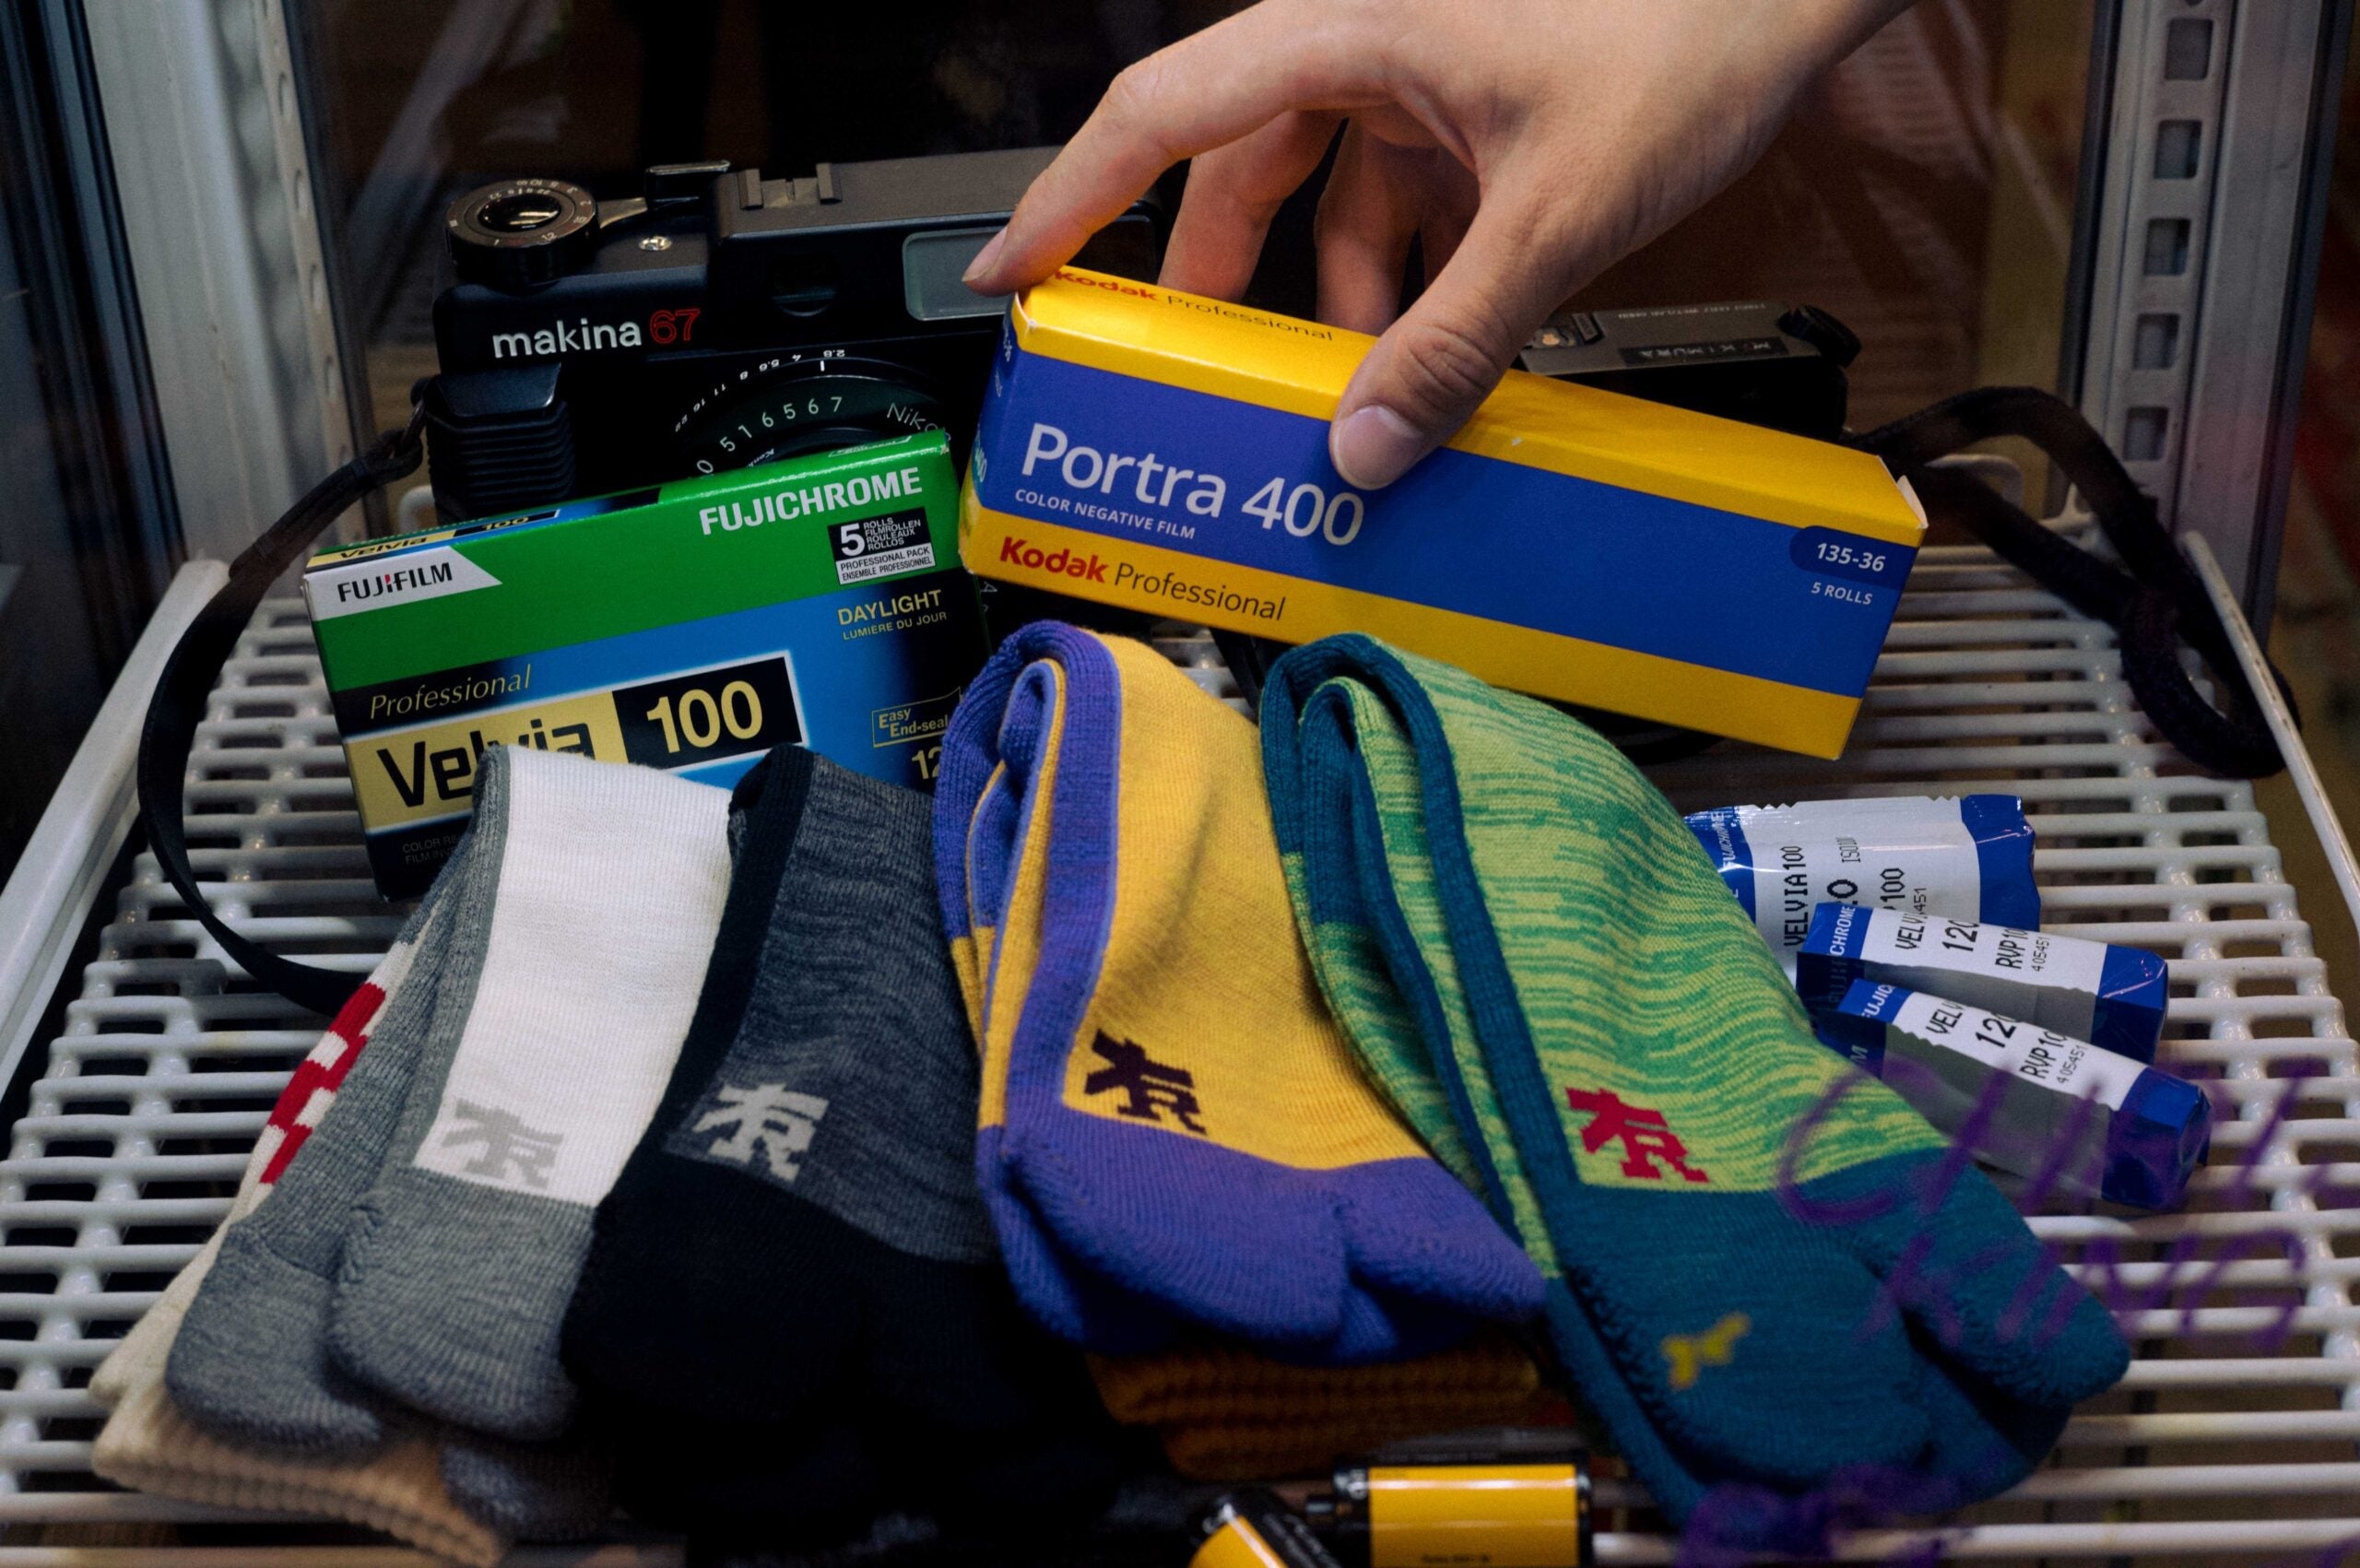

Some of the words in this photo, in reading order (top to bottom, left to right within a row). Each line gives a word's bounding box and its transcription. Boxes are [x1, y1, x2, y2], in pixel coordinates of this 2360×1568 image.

[1054, 270, 1158, 301] Kodak
[1167, 295, 1333, 342] Professional
[492, 317, 643, 359] makina
[649, 307, 701, 345] 67
[759, 359, 780, 371] 5.6
[792, 354, 802, 362] 4
[823, 349, 845, 358] 2.8
[739, 371, 749, 381] 8
[714, 383, 726, 396] 11
[1021, 421, 1227, 518] Portra
[1241, 477, 1365, 547] 400
[699, 466, 923, 536] FUJICHROME
[1015, 488, 1070, 513] COLOR
[1074, 501, 1154, 531] NEGATIVE
[1156, 519, 1196, 540] FILM
[339, 537, 428, 559] Velvia
[481, 516, 530, 532] 100
[840, 522, 866, 557] 5
[863, 517, 894, 530] ROLLS
[865, 519, 922, 536] FILMROLLEN
[866, 528, 915, 544] ROULEAUX
[867, 537, 904, 551] ROLLOS
[1817, 542, 1886, 572] 135-36
[840, 551, 906, 572] PROFESSIONAL
[906, 546, 931, 558] PACK
[842, 567, 878, 582] ENSEMBLE
[879, 557, 933, 574] PROFESSIONNEL
[336, 561, 454, 603] FUJIFILM
[998, 535, 1110, 584] Kodak
[1114, 562, 1287, 621] Professional
[1811, 581, 1822, 595] 5
[1824, 584, 1873, 606] ROLLS
[837, 588, 942, 626] DAYLIGHT
[896, 618, 913, 630] DU
[915, 611, 948, 627] JOUR
[370, 663, 532, 720] Professional
[645, 679, 763, 755] 100
[878, 707, 912, 729] Easy
[890, 714, 949, 738] End-seal
